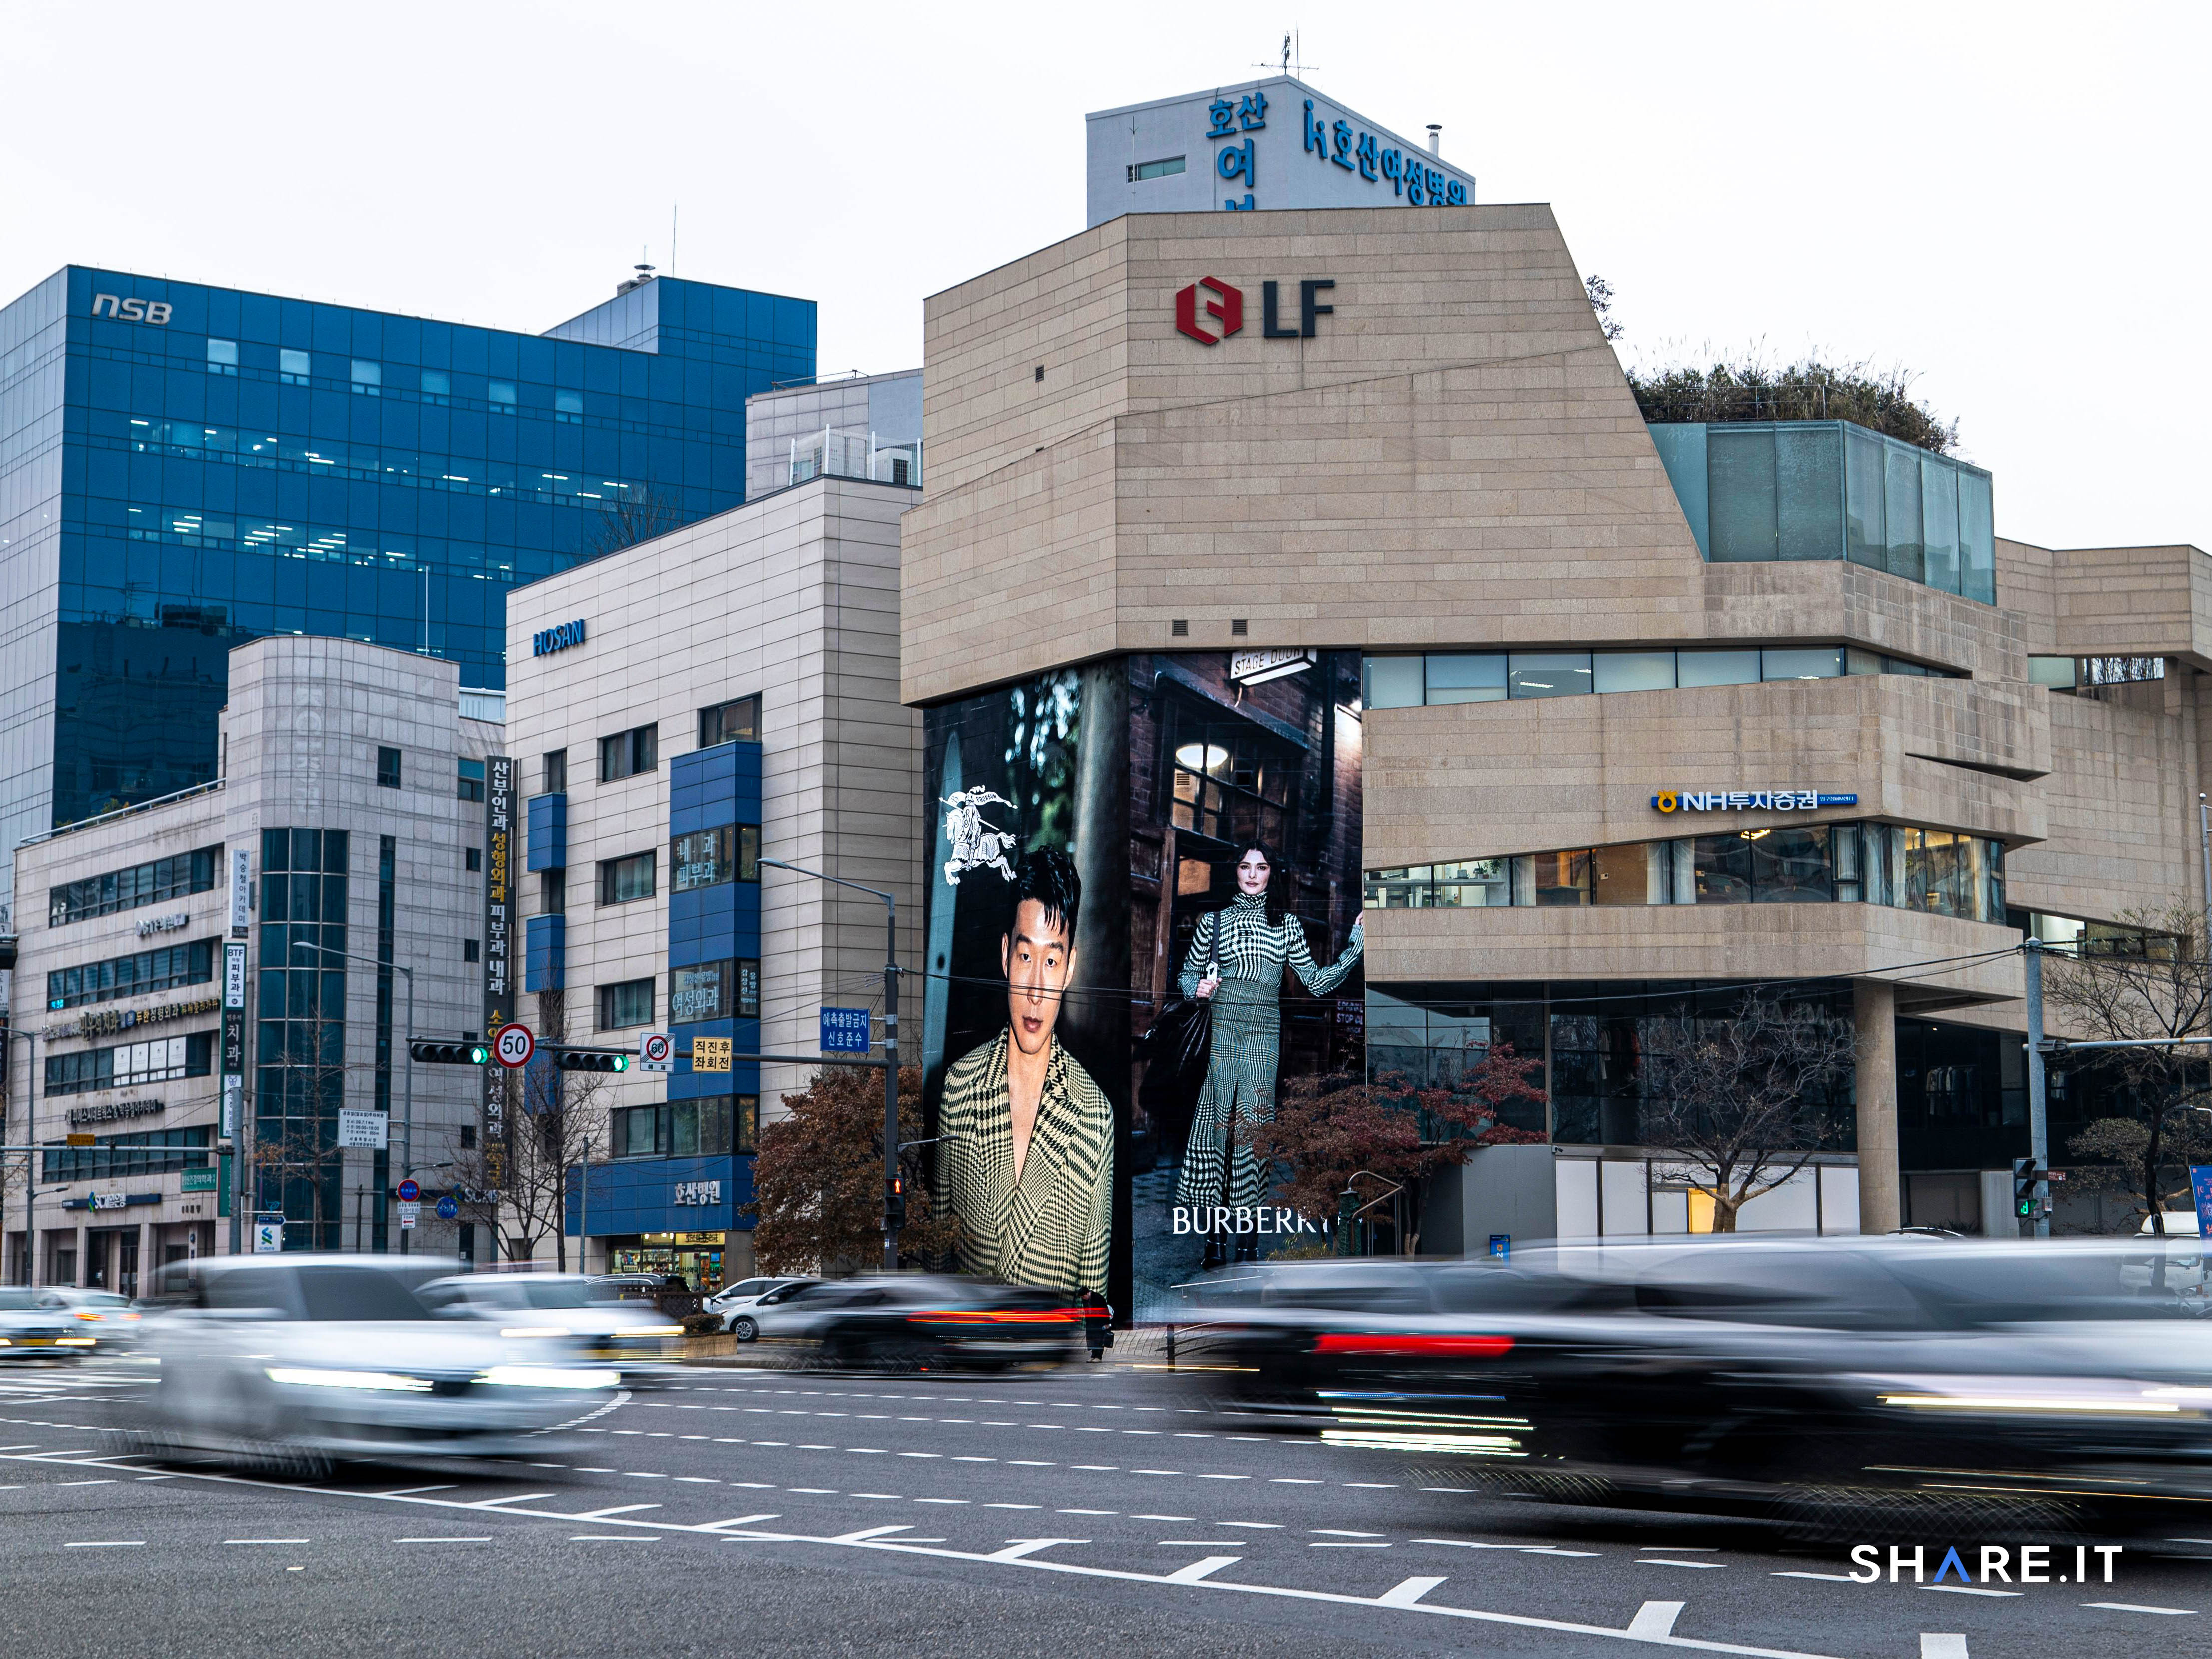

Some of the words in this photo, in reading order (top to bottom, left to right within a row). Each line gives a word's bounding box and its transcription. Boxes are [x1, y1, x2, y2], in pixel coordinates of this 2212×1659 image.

[1206, 92, 1268, 137] 호산
[1332, 119, 1467, 205] 호산여성병원
[1263, 280, 1335, 337] LF
[533, 619, 584, 657] HOSAN
[1235, 652, 1264, 675] STAGE
[492, 761, 509, 831] 산부인과
[976, 794, 997, 802] PRORSUM
[1683, 790, 1818, 811] NH투자증권
[490, 832, 506, 902] 성형외과
[679, 859, 716, 887] 피부과
[238, 852, 247, 923] 박승철아카데미
[490, 905, 506, 957] 피부과
[230, 964, 240, 992] 피부과
[488, 960, 505, 995] 내과
[136, 1003, 179, 1024] 두한성형외과
[672, 986, 719, 1016] 여성외과
[823, 1012, 867, 1029] 예측출발금지
[226, 1024, 241, 1062] 치과
[502, 1036, 526, 1055] 50
[651, 1043, 664, 1054] 60
[695, 1040, 730, 1054] 직진후
[828, 1031, 862, 1047] 신호준수
[695, 1056, 729, 1069] 좌회전
[95, 1193, 126, 1209] SC제일은행
[674, 1181, 720, 1205] 호산병원
